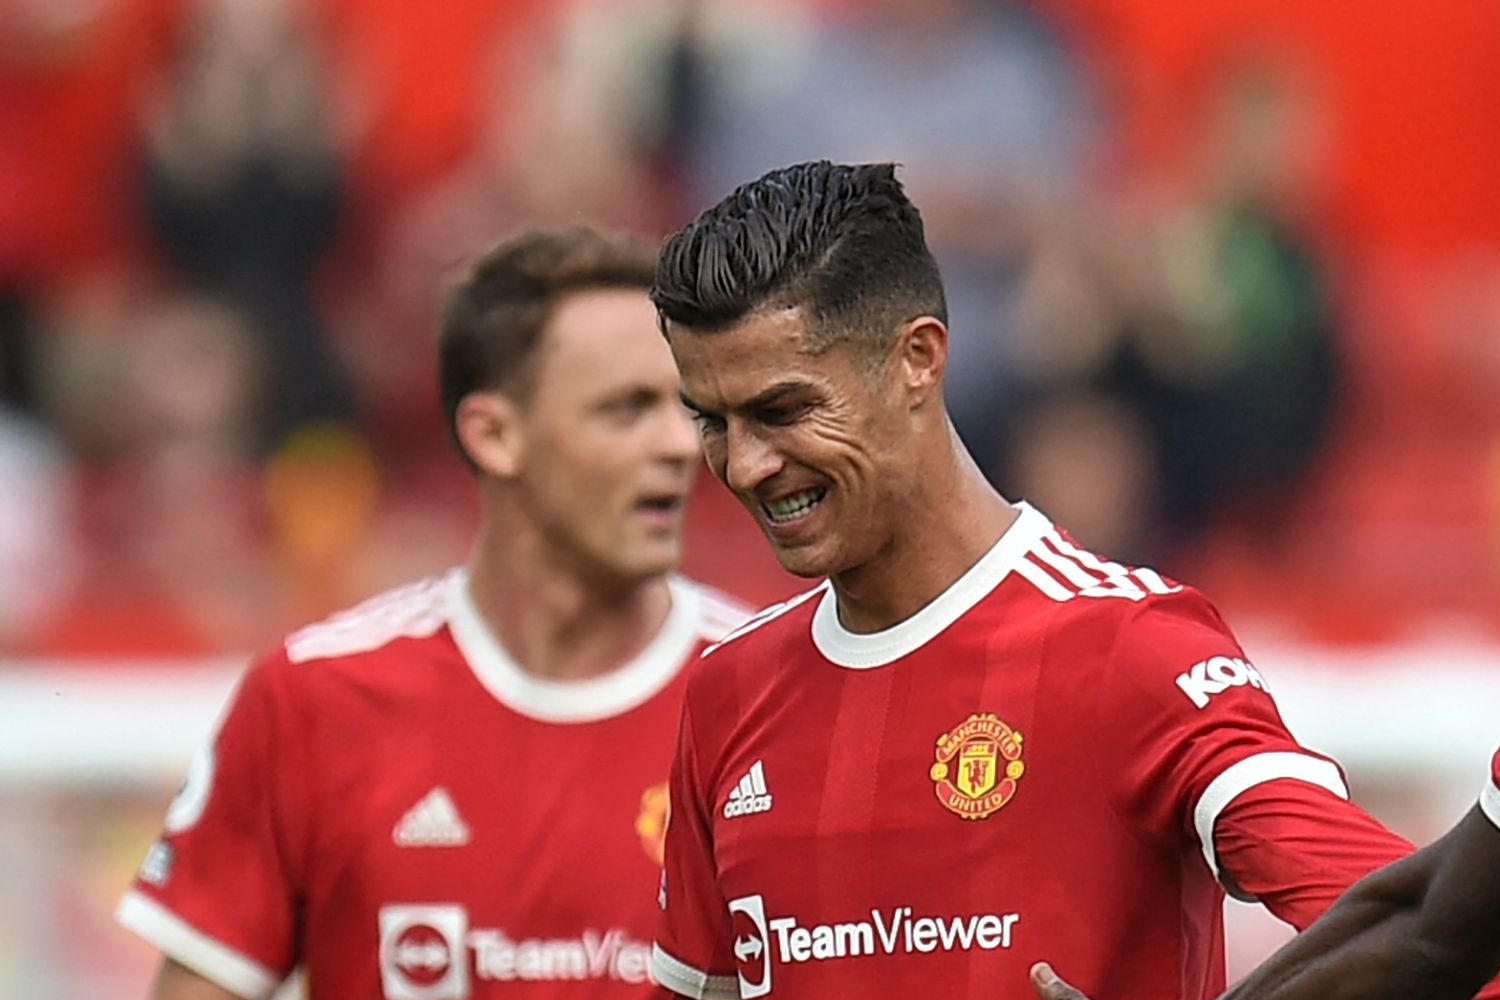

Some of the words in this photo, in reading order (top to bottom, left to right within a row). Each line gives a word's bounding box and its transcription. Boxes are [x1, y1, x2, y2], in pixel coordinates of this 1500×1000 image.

[942, 721, 1018, 756] MANCHESTER
[723, 793, 773, 819] adidas
[948, 792, 1003, 813] UNITED
[769, 906, 1020, 963] TeamViewer
[465, 928, 660, 984] TeamVie
